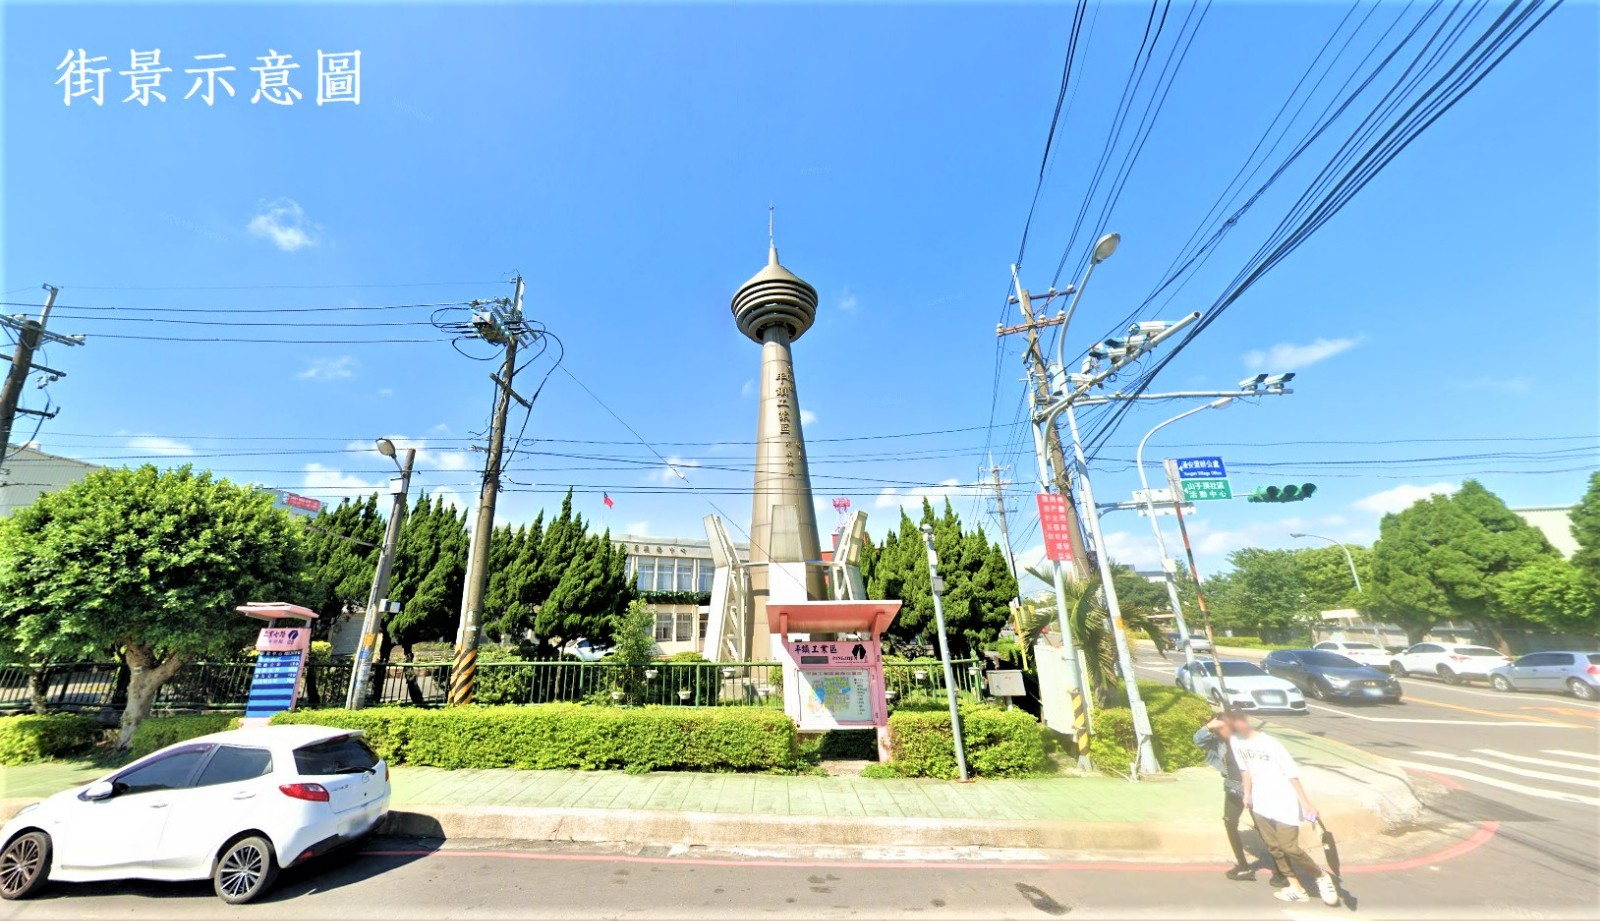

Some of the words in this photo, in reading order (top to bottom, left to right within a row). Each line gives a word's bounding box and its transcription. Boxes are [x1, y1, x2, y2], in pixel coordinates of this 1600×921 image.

[1187, 481, 1225, 490] 山子頂社區
[1189, 490, 1226, 498] 活動中心
[795, 644, 838, 654] 平鎮工業區
